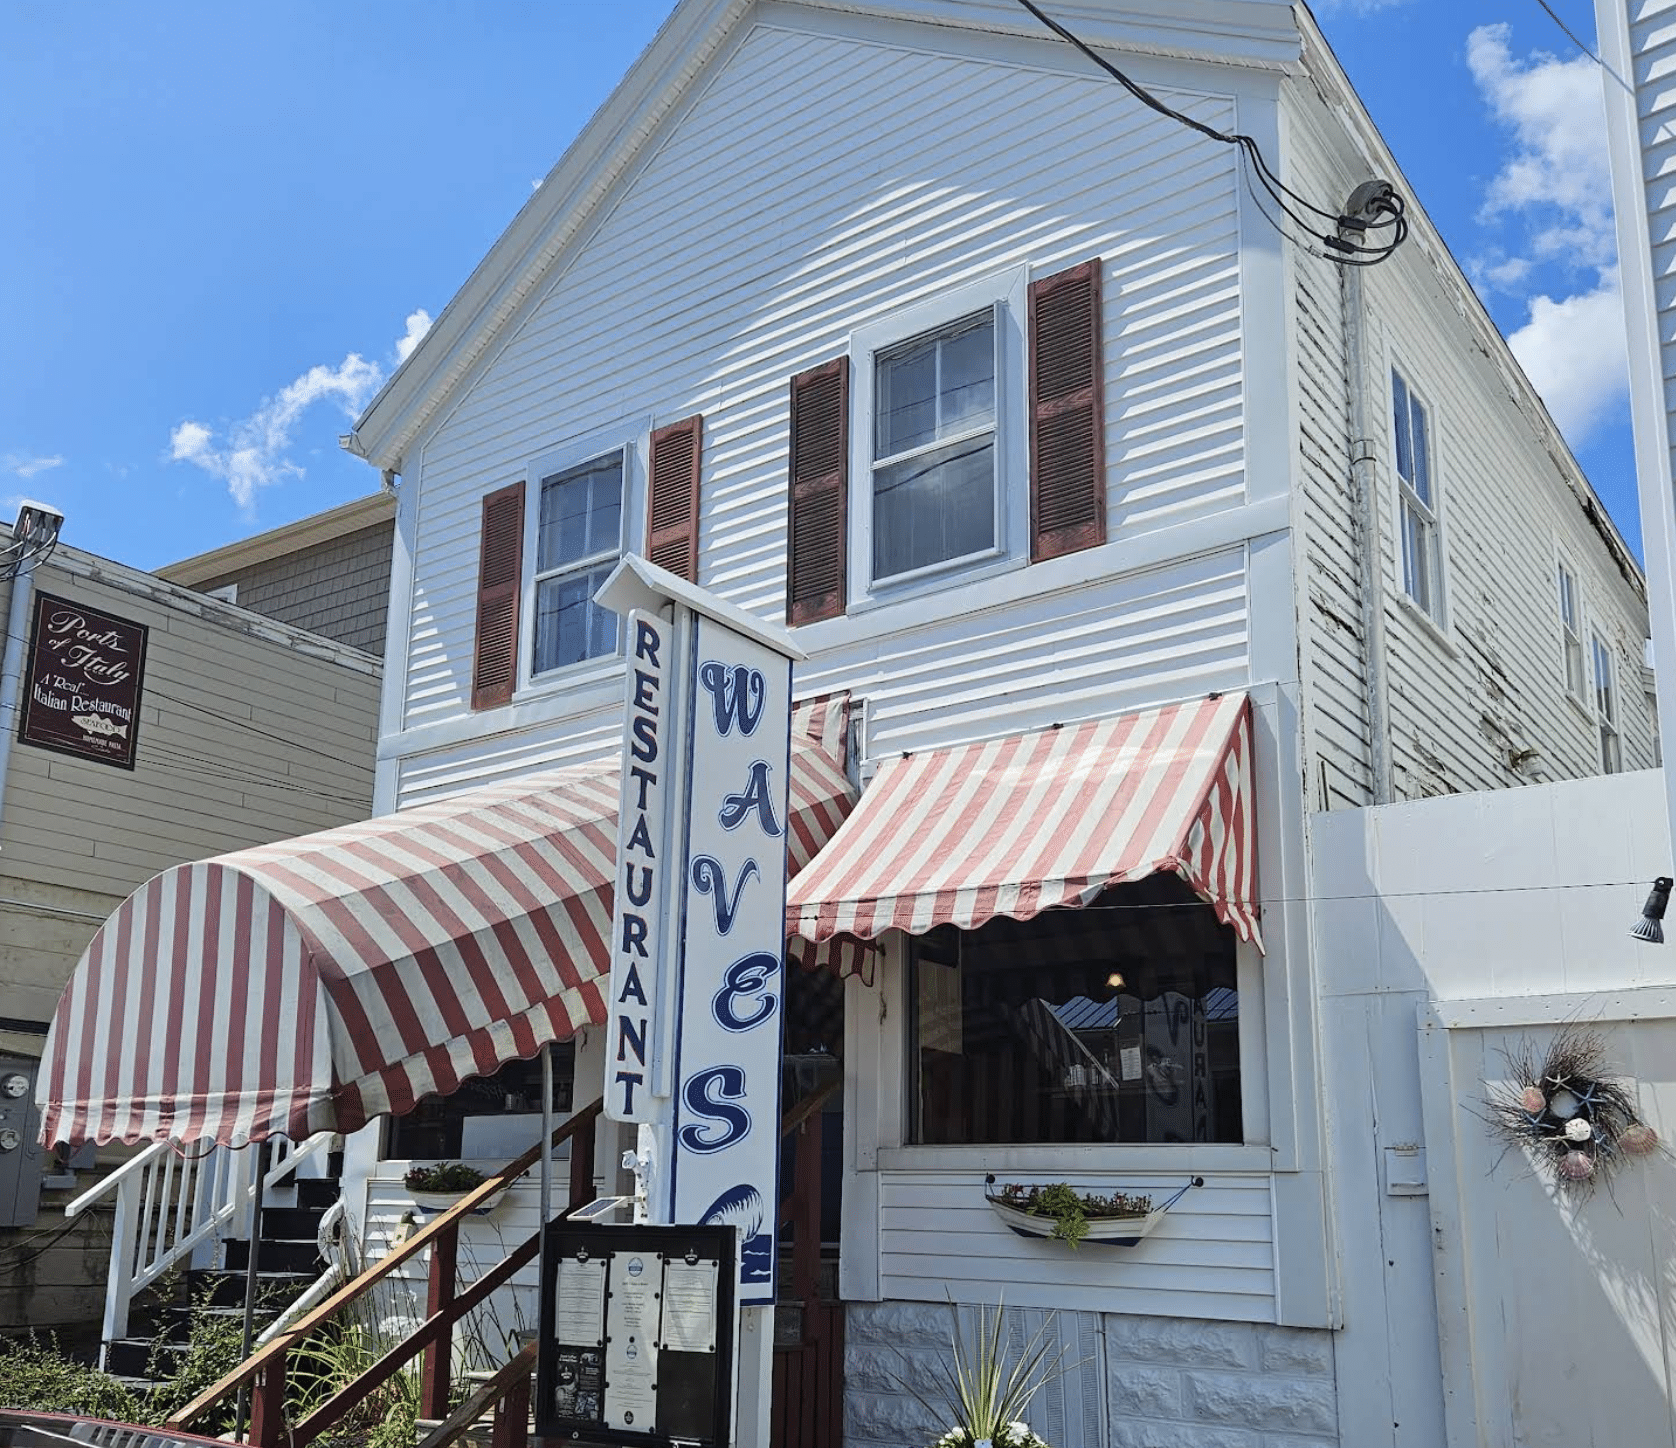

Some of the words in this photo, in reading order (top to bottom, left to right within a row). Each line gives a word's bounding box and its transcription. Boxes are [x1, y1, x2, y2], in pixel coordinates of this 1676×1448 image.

[48, 611, 128, 653] Ports
[40, 673, 50, 685] A
[48, 638, 72, 650] of
[61, 645, 131, 685] Italy
[34, 683, 67, 711] Italian
[70, 695, 132, 723] Restaurant
[615, 619, 660, 1115] RESTAURANT
[678, 660, 783, 1155] WAVES
